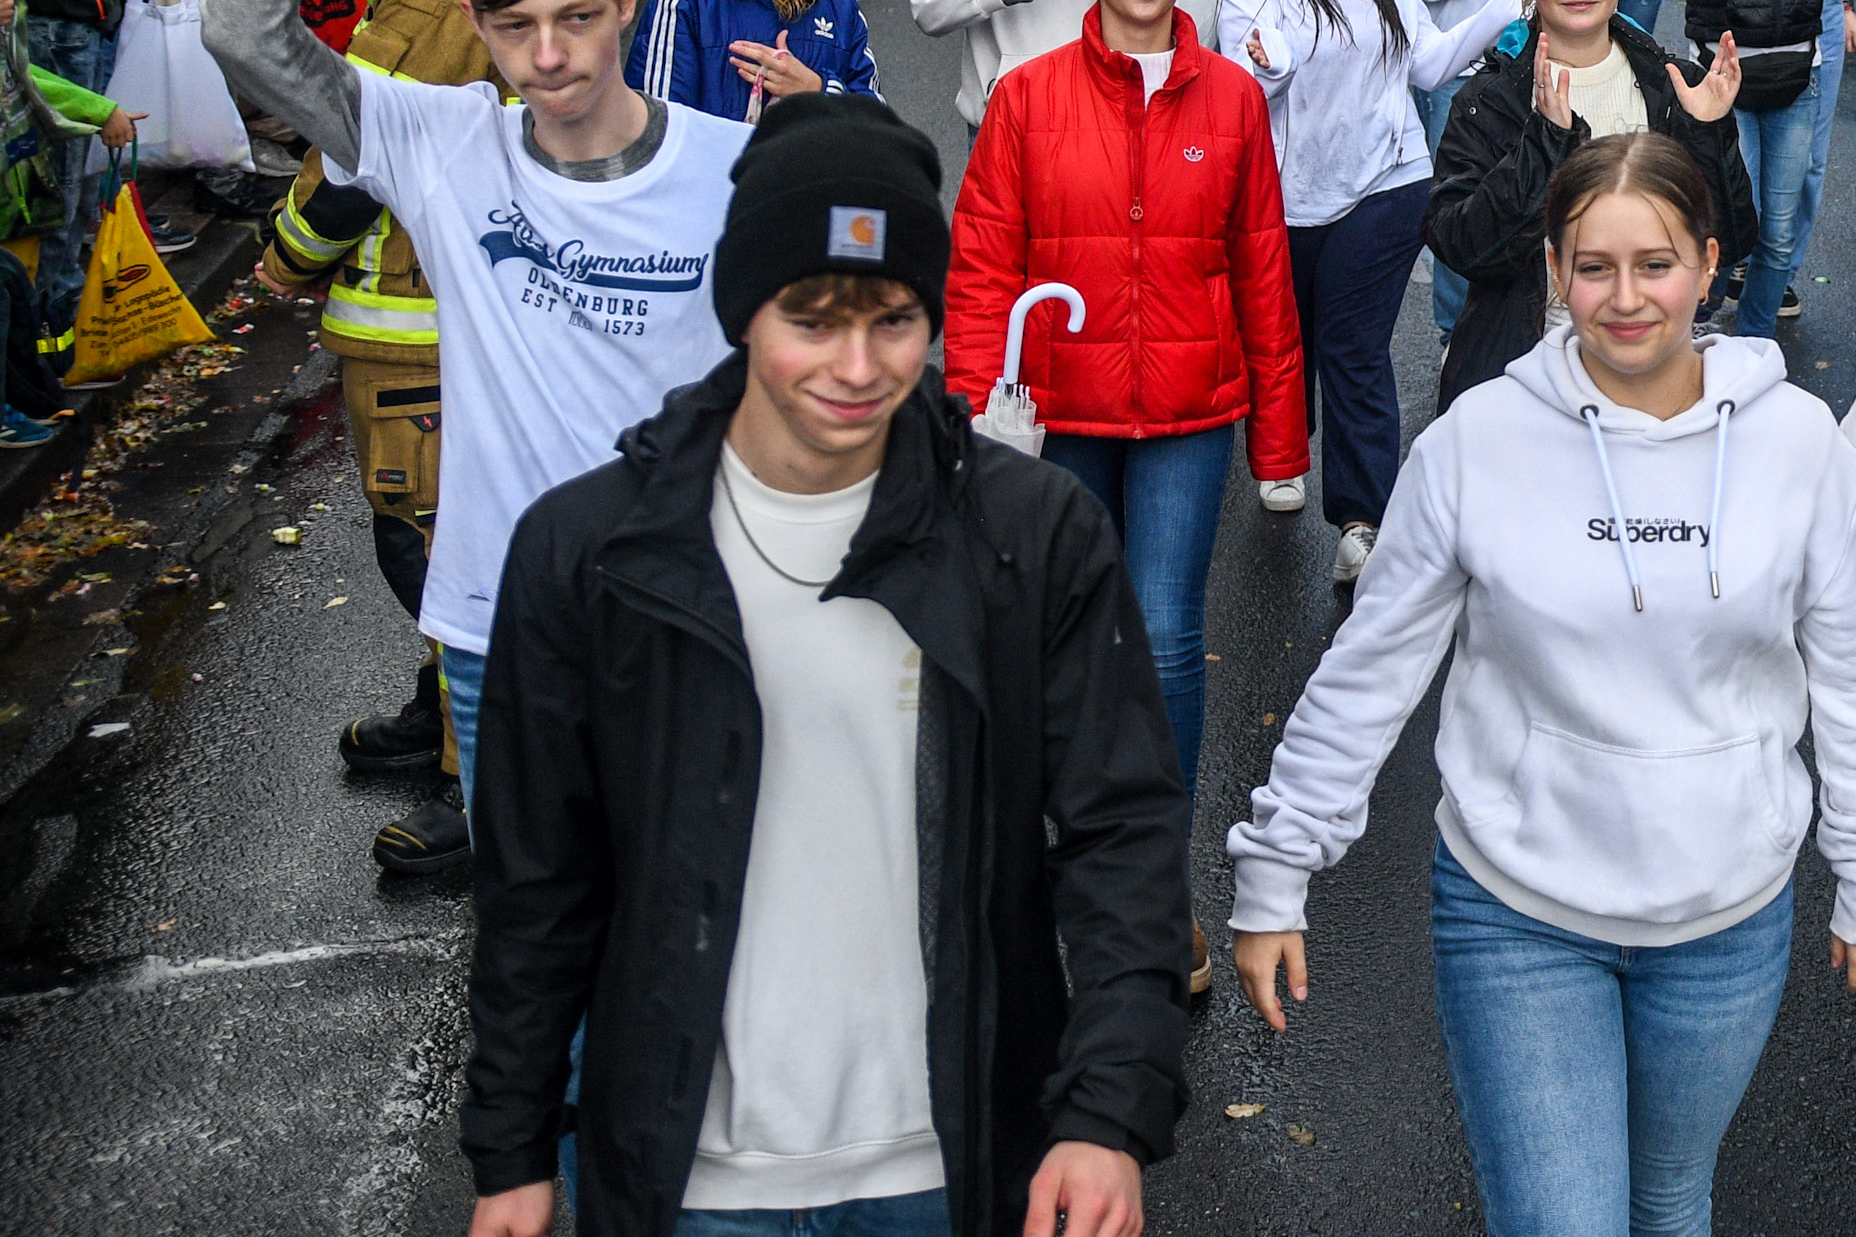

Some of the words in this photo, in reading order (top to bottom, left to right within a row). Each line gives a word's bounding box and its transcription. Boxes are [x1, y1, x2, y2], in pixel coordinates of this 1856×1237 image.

[556, 239, 710, 280] Gymnasium
[521, 288, 558, 313] EST
[604, 318, 646, 336] 1573
[1587, 518, 1711, 548] Superdry
